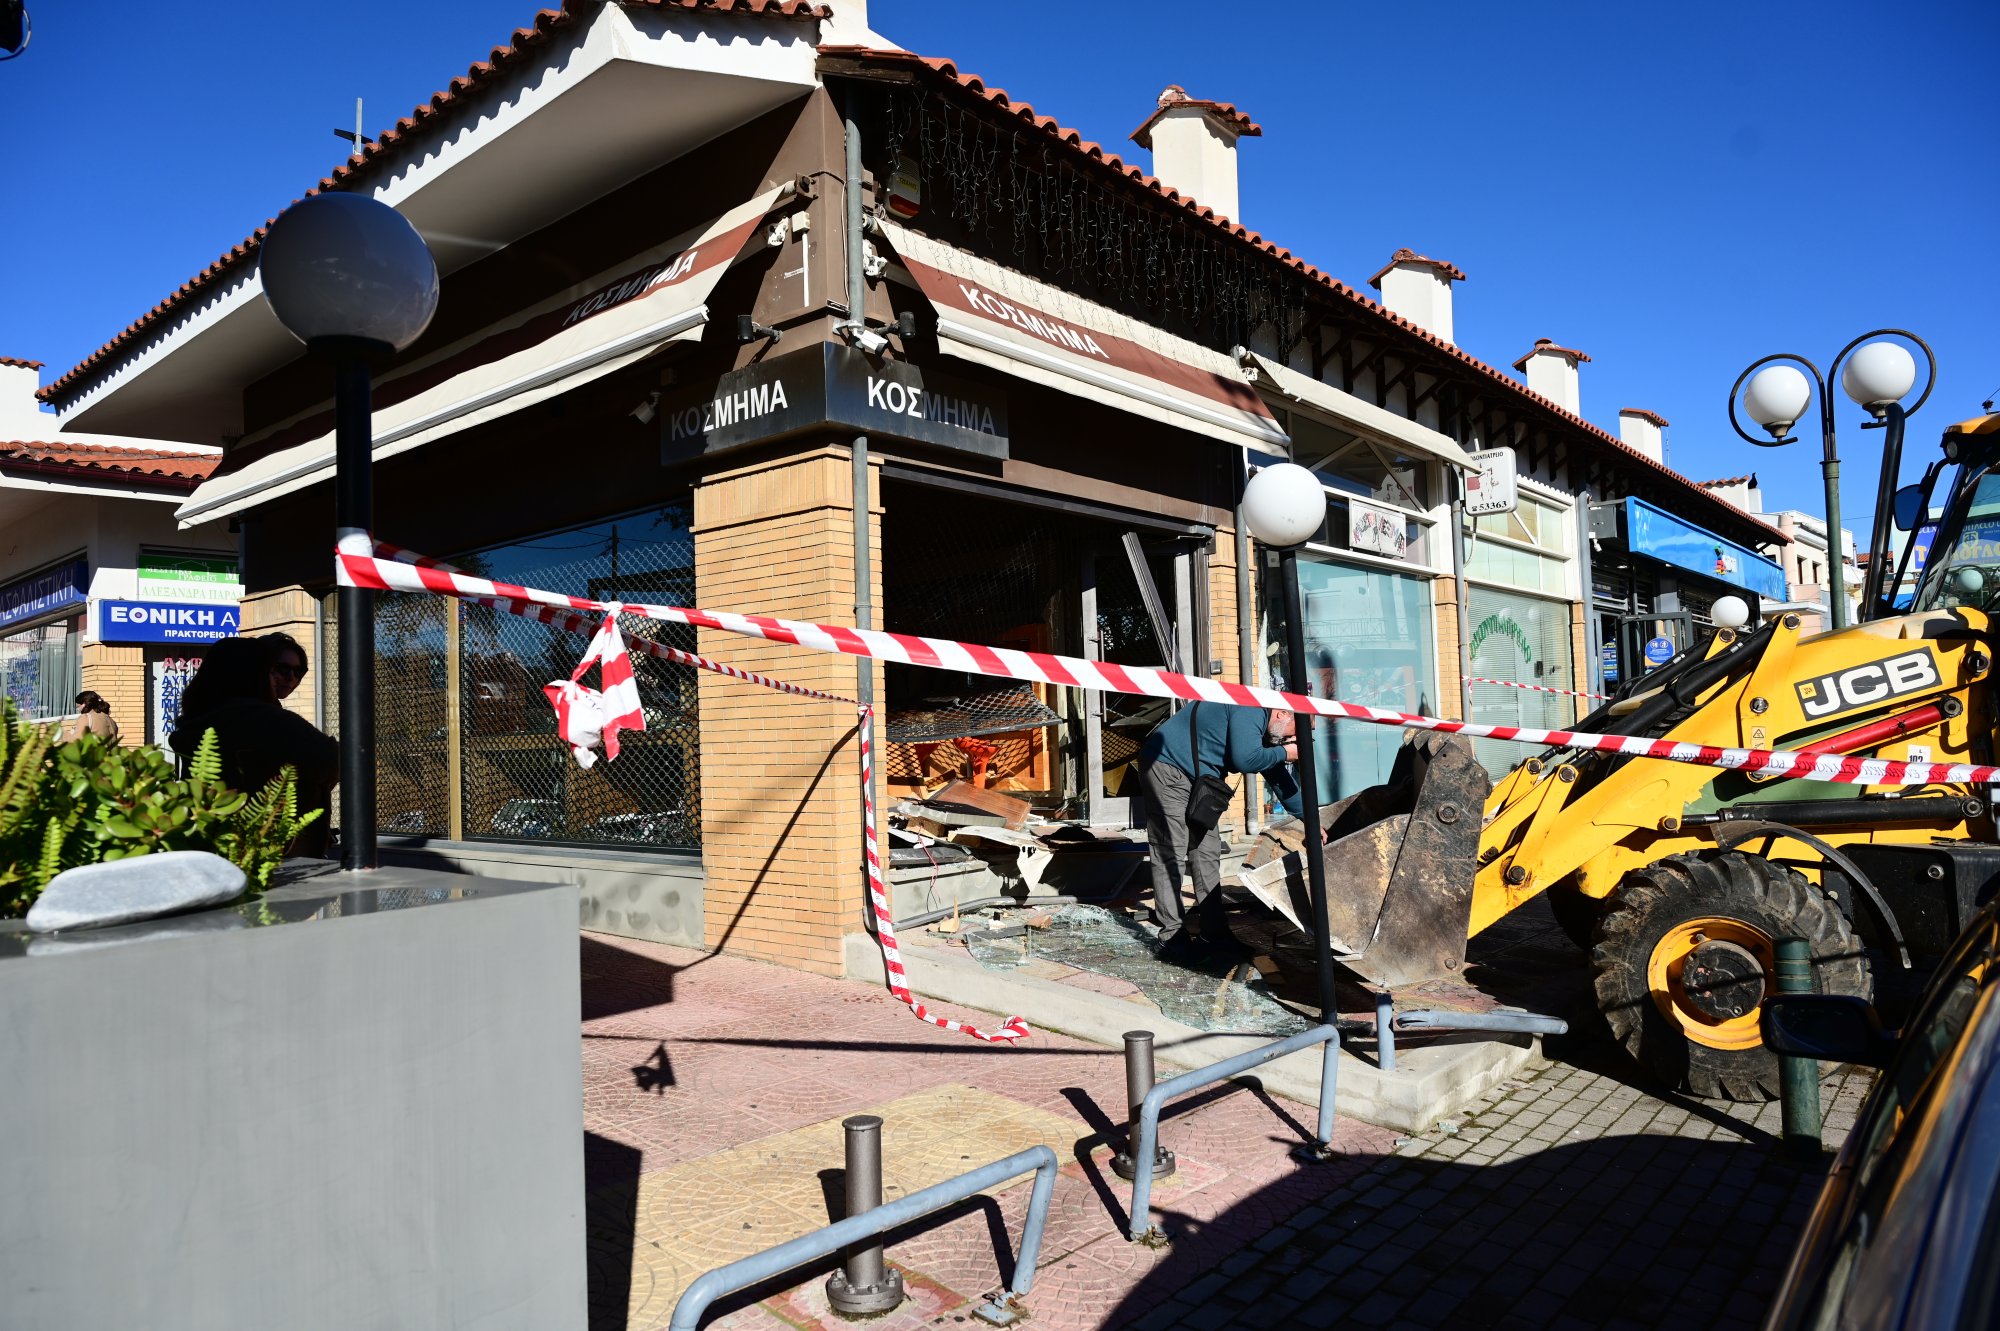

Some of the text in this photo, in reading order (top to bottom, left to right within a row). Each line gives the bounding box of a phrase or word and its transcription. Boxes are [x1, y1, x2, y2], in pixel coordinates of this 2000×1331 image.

[562, 251, 698, 326] ΚΟΣΜΗΜΑ
[959, 283, 1110, 359] ΚΟΣΜΗΜΑ
[671, 379, 788, 442] ΚΟΣΜΗΜΑ
[867, 376, 996, 436] ΚΟΣΜΗΜΑ
[1479, 500, 1507, 511] 53363
[142, 586, 206, 599] ΑΛΕΞΑΝΔΡΑ
[164, 629, 226, 639] ΠΡΑΚΤΟΡΕΙΟ
[1803, 652, 1936, 716] JCB
[1747, 756, 1785, 769] POLICE
